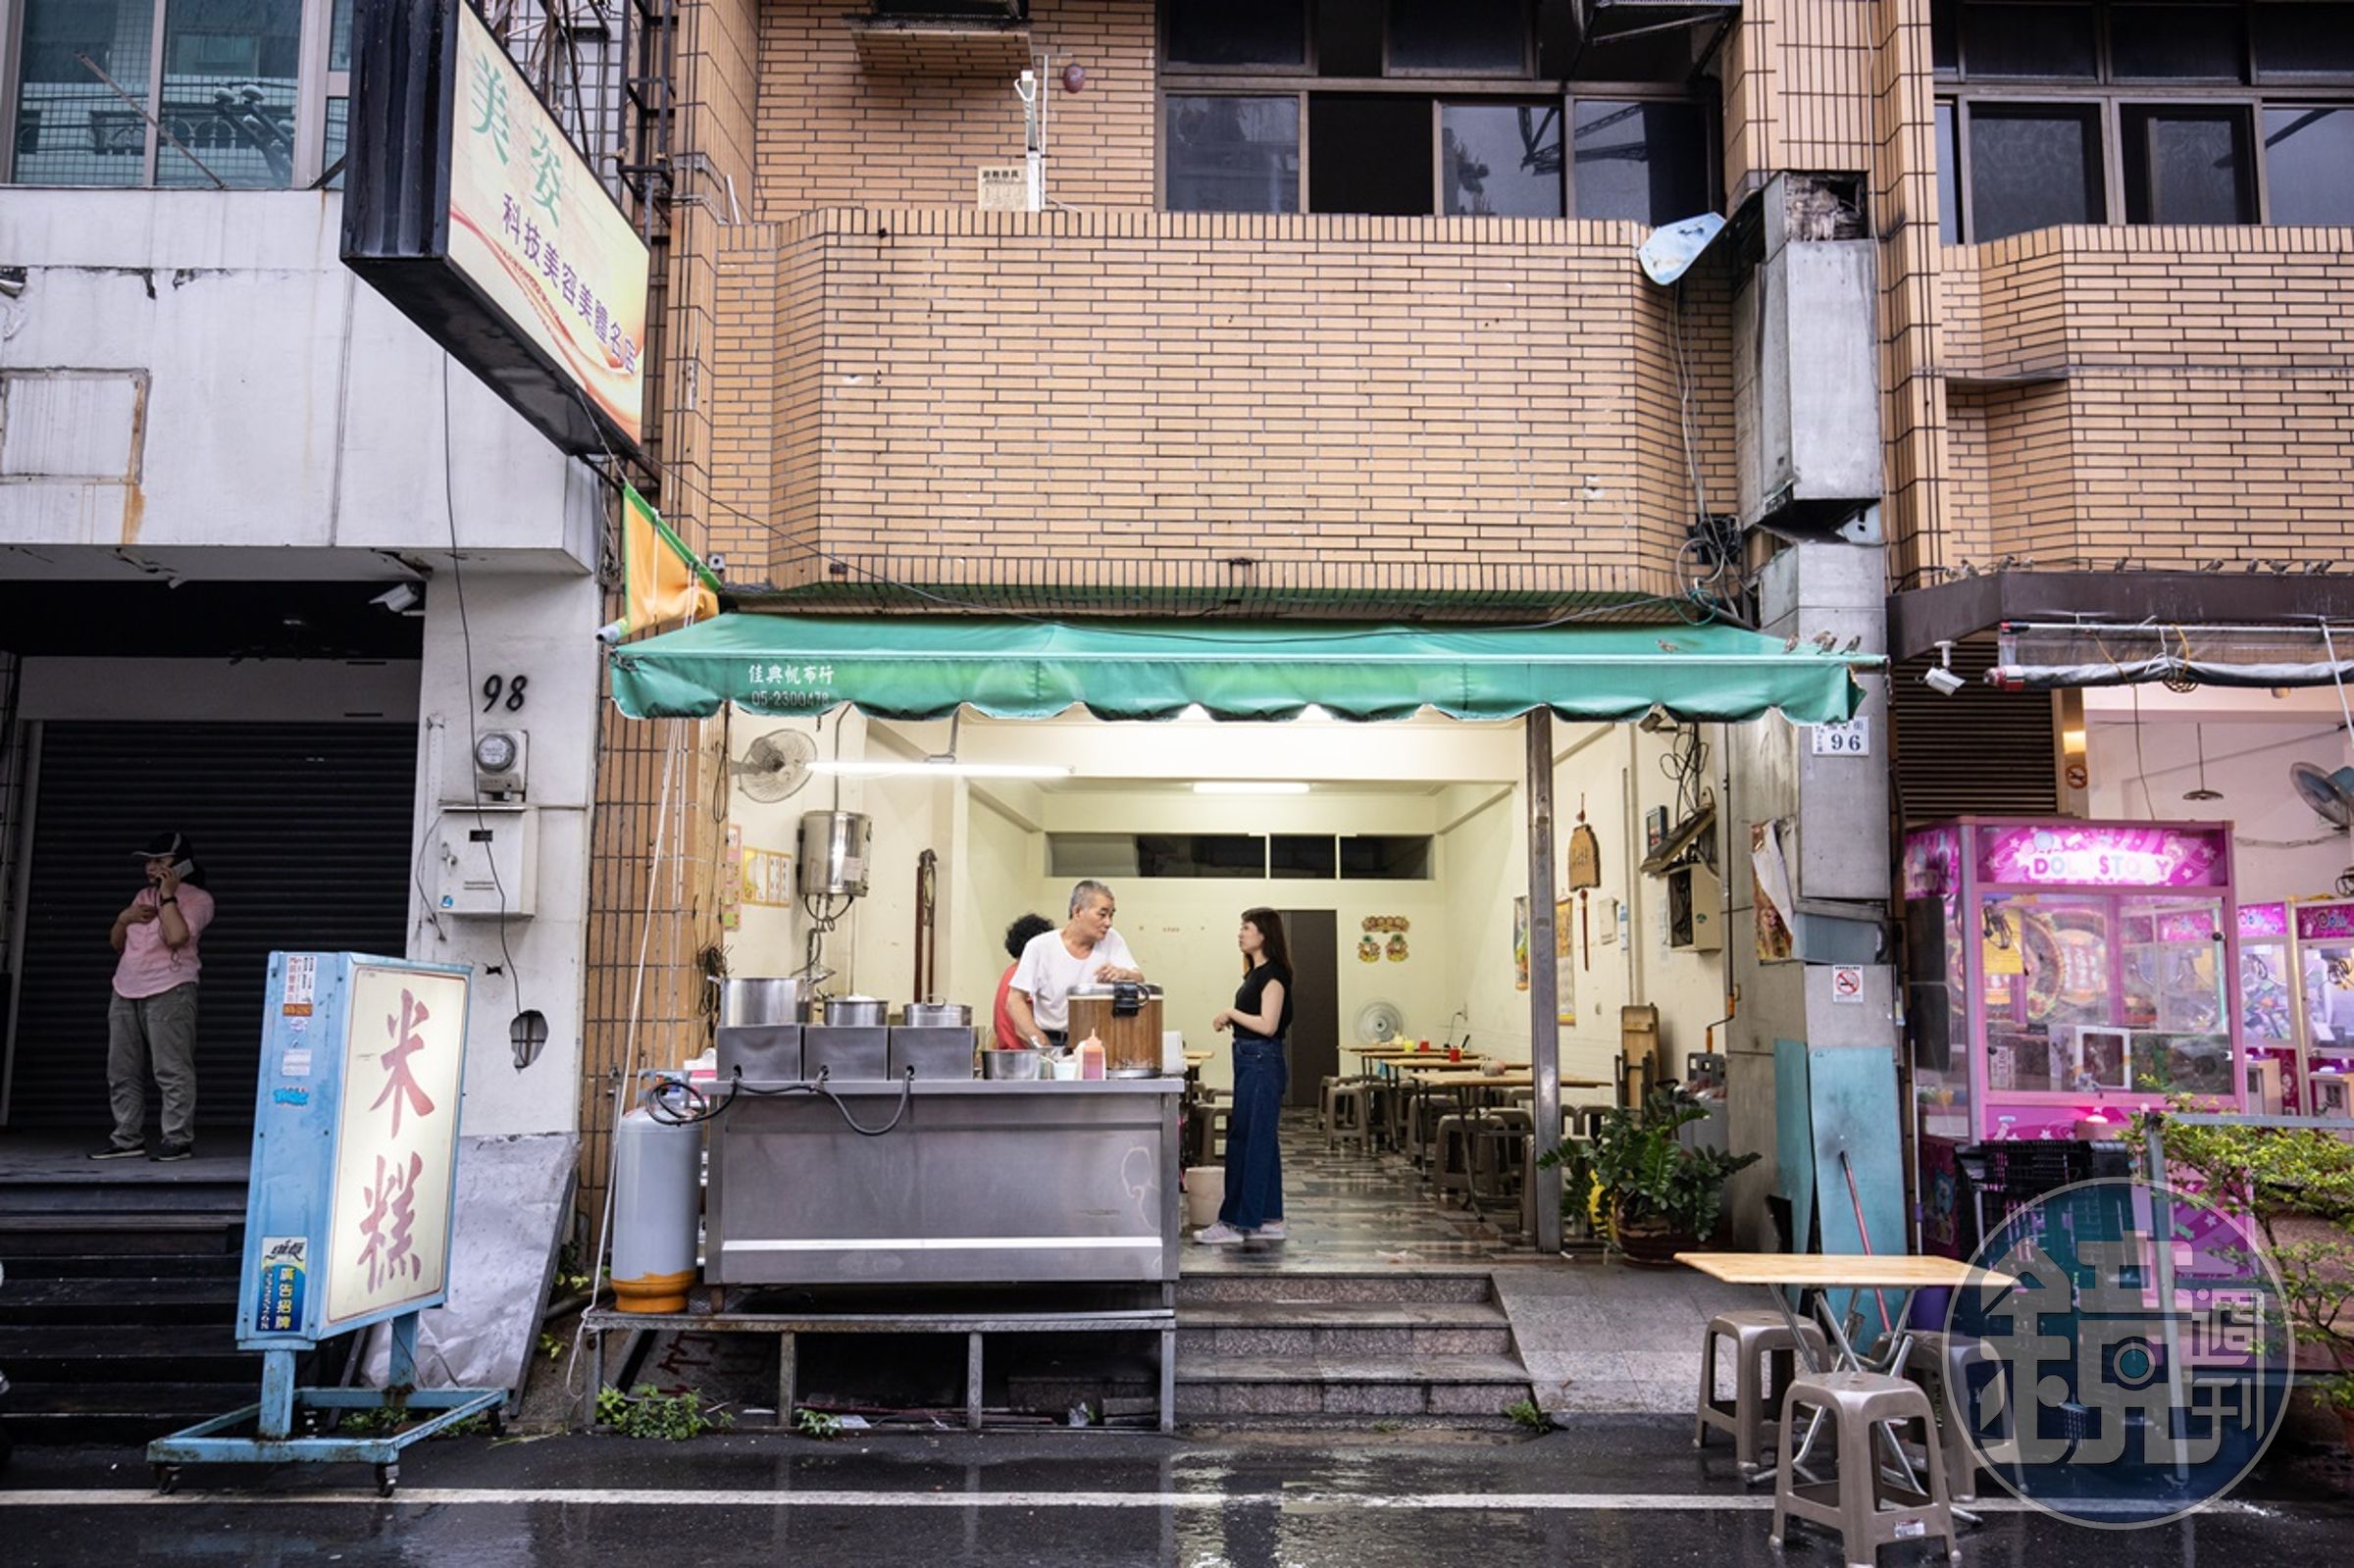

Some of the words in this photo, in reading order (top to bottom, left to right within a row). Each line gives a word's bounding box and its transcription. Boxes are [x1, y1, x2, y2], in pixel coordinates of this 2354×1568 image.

[483, 674, 528, 713] 98
[1830, 733, 1861, 752] 96
[357, 987, 435, 1294] 米糕
